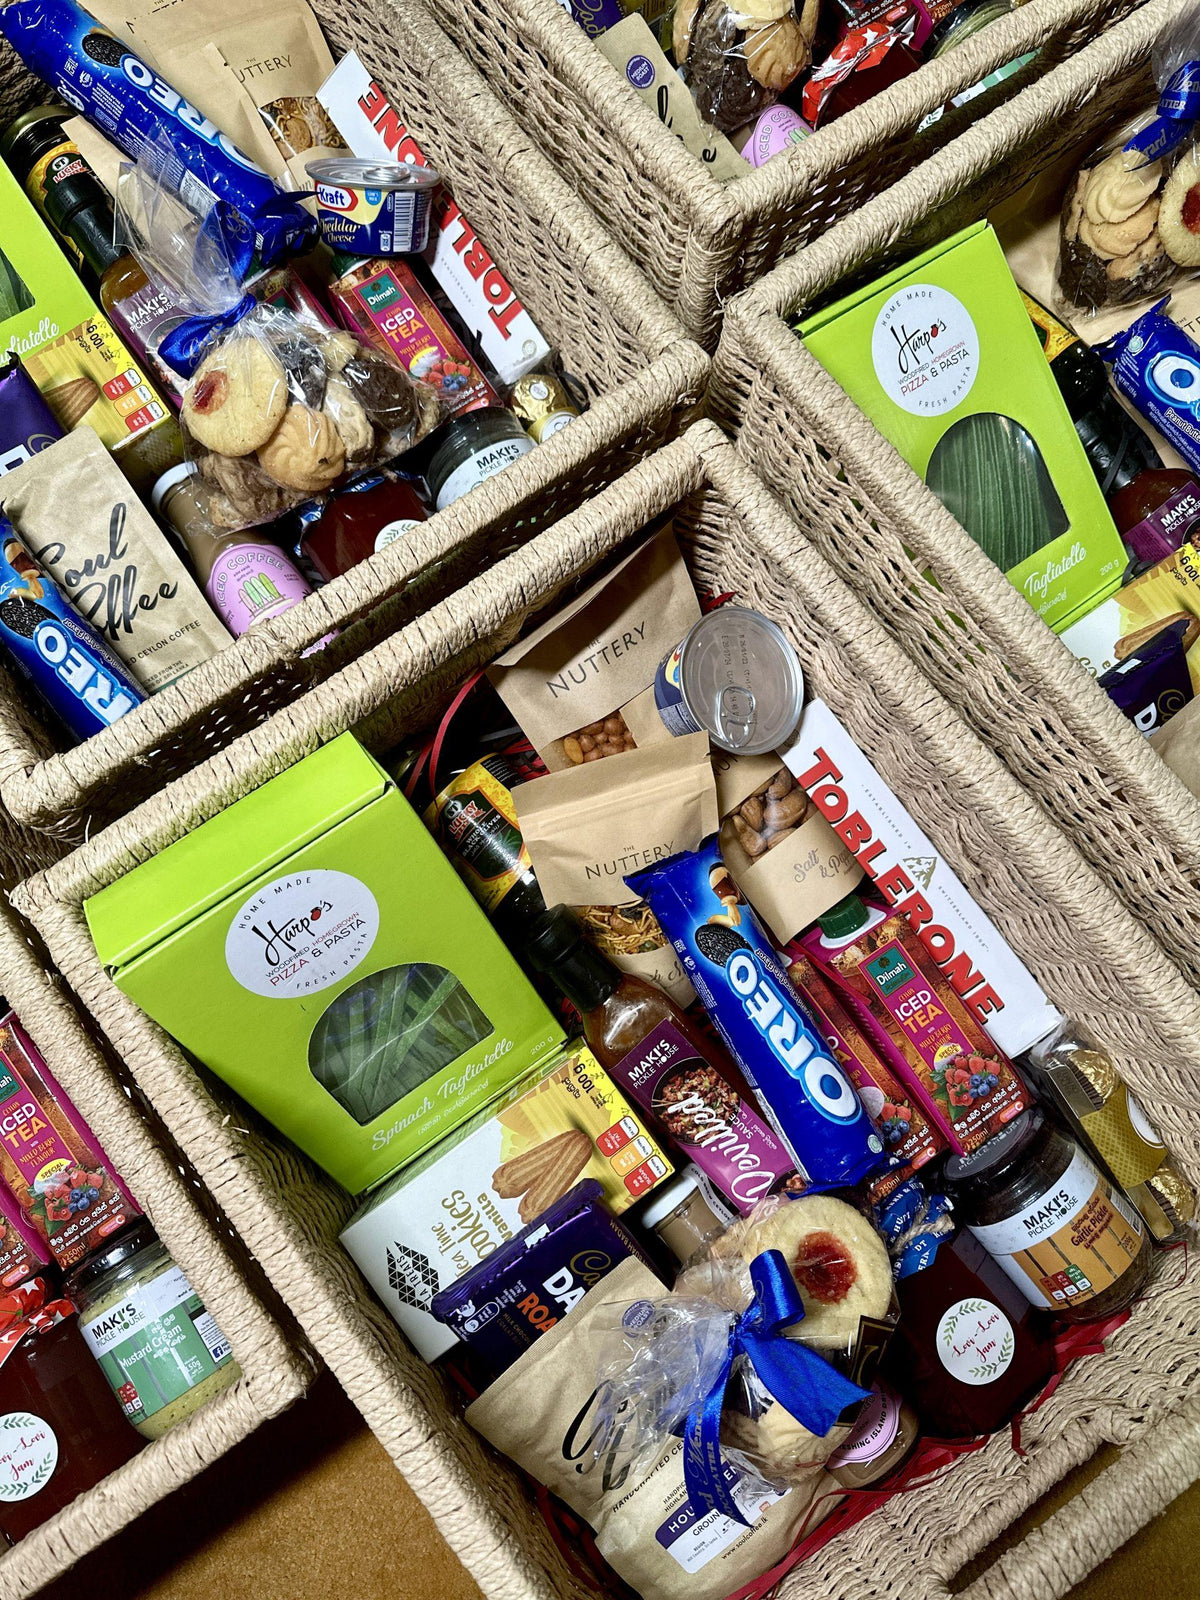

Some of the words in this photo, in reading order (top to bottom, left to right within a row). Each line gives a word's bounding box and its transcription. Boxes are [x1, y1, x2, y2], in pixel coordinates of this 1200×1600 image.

[236, 54, 293, 83] UTTERY
[630, 61, 648, 79] MEDIUM
[122, 56, 268, 177] OREO
[760, 125, 773, 159] ICED
[53, 159, 85, 184] LUCKY
[318, 186, 346, 208] Kraft
[357, 80, 524, 341] TOBLEONE
[126, 292, 169, 325] MAKI'S
[366, 284, 397, 308] Dilmah
[880, 298, 905, 328] HOME
[906, 289, 935, 302] MADE
[129, 316, 154, 335] PICKLE
[152, 300, 177, 323] HOUSE
[380, 308, 417, 335] ICED
[386, 320, 426, 345] TEA
[896, 362, 932, 386] WOODFIRED
[930, 340, 967, 366] HOMEGROWN
[900, 373, 929, 398] PIZZA
[929, 366, 939, 378] &
[939, 347, 971, 373] PASTA
[918, 396, 949, 409] FRESH
[951, 364, 972, 397] PASTA
[1166, 409, 1188, 432] Peanut
[1185, 421, 1200, 443] Butte
[476, 443, 521, 470] MAKI'S
[478, 459, 503, 478] PICKLE
[1160, 494, 1196, 528] MAKI'S
[1164, 514, 1186, 536] PICKLE
[1184, 500, 1200, 520] HOUS
[217, 571, 230, 608] ICED
[226, 551, 286, 573] COFFEE
[1023, 540, 1088, 600] Tagliatelle
[76, 564, 178, 642] Cffee
[59, 616, 86, 639] Flavor
[137, 639, 169, 661] CEYLON
[167, 619, 202, 642] COFFEE
[36, 625, 137, 723] REO
[546, 621, 647, 699] NUTTERY
[584, 840, 675, 881] NUTTERY
[622, 844, 636, 853] THE
[792, 846, 820, 884] Salt
[796, 745, 1006, 1024] TOBLERONE
[238, 898, 266, 930] HOME
[273, 876, 312, 896] MADE
[251, 899, 334, 967] Harpo's
[265, 946, 310, 979] WOODFIRED
[312, 911, 360, 946] HOMEGROWN
[269, 958, 310, 987] PIZZA
[311, 947, 323, 958] &
[324, 919, 367, 949] PASTA
[296, 970, 337, 990] FRESH
[343, 932, 369, 966] PASTA
[875, 961, 908, 988] Dilmah
[894, 988, 933, 1022] ICED
[902, 1003, 944, 1035] TEA
[529, 1041, 546, 1056] 200
[727, 952, 858, 1118] OREO
[572, 1061, 587, 1075] g
[627, 1039, 672, 1082] MAKI'S
[632, 1066, 658, 1090] PICKLE
[655, 1044, 681, 1068] HOUSE
[371, 1097, 435, 1152] Spinach
[437, 1036, 514, 1105] Tagliatelle
[575, 1071, 596, 1095] 100
[4, 1116, 49, 1150] TEA
[728, 1111, 755, 1139] SAUCE
[967, 1128, 989, 1148] 250ml
[667, 1090, 776, 1204] Devilled
[40, 1160, 65, 1180] SPECIAL
[880, 1175, 901, 1195] 250ml
[440, 1189, 499, 1261] ookies
[1022, 1188, 1070, 1231] MAKI'S
[1027, 1214, 1056, 1239] PICKLE
[1054, 1194, 1079, 1222] HOUSE
[1070, 1221, 1092, 1248] Garlic
[1087, 1203, 1110, 1230] Pickle
[63, 1241, 87, 1261] 250ml
[431, 1221, 458, 1258] Time
[396, 1254, 421, 1289] TREATS
[450, 1250, 466, 1279] Tea
[422, 1285, 434, 1302] LA
[90, 1302, 137, 1340] MAKI'S
[95, 1328, 118, 1350] PICKLE
[116, 1310, 147, 1336] HOUSE
[516, 1292, 559, 1333] ROA
[119, 1337, 154, 1370] Mustard
[151, 1322, 184, 1350] Cream
[975, 1338, 997, 1365] Jam
[870, 1411, 890, 1442] ISLAND
[0, 1429, 46, 1466] ovi-Lovi
[9, 1456, 35, 1482] Jam
[662, 1479, 688, 1505] HANDPIC
[664, 1488, 690, 1513] HIGHLAN
[667, 1502, 697, 1534] HOU
[691, 1510, 722, 1537] GROUN
[720, 1516, 770, 1560] www.soulcoffee.lk
